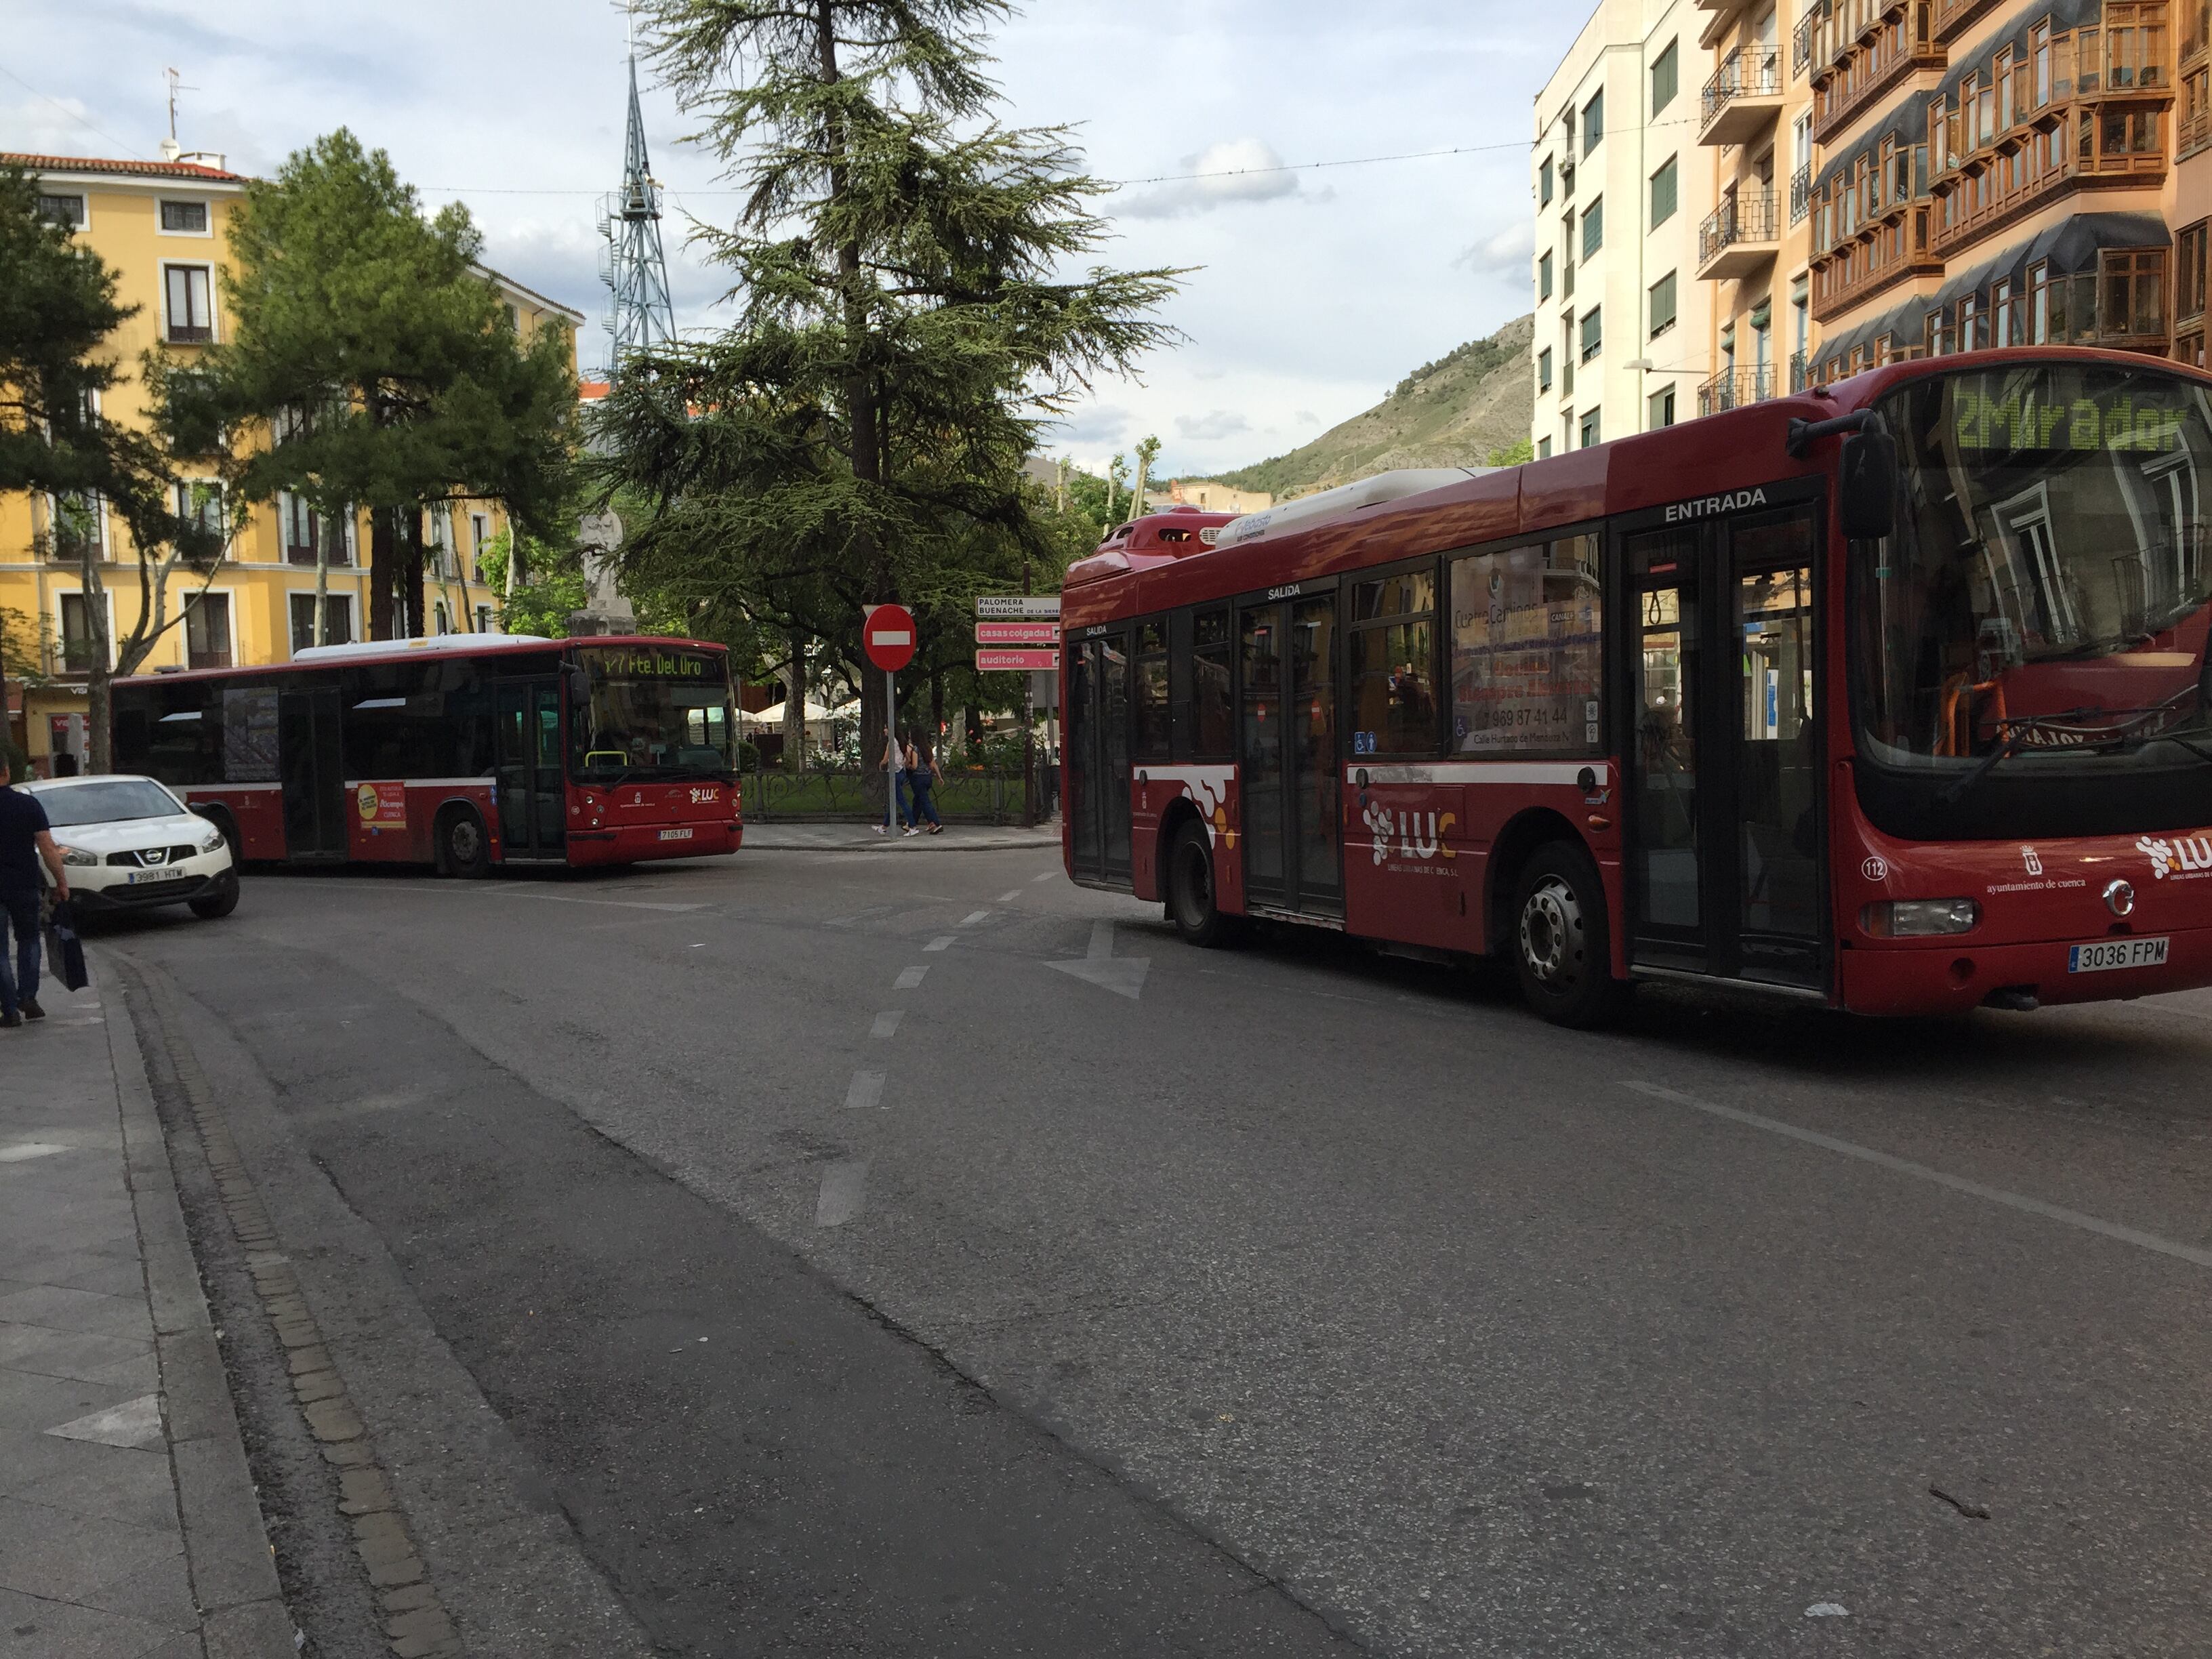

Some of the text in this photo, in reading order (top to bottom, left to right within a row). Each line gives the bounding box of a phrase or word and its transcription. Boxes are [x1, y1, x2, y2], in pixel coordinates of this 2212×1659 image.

[1666, 488, 1767, 522] ENTRADA
[1268, 584, 1300, 600] SALIDA
[1551, 611, 1574, 623] CANAL+
[1008, 629, 1050, 639] colgadas
[1087, 626, 1107, 636] SALIDA
[657, 655, 677, 674] Del
[680, 655, 701, 675] Oro
[981, 655, 1025, 663] auditorio
[1492, 710, 1513, 726] 969
[1517, 708, 1531, 726] 87
[1552, 707, 1567, 724] 44
[701, 789, 719, 800] LUC
[1399, 811, 1456, 859] LUC
[1866, 861, 1883, 876] 112
[1987, 879, 2087, 895] ayuntamiento de cuenca
[2082, 941, 2165, 967] 3036 FPM
